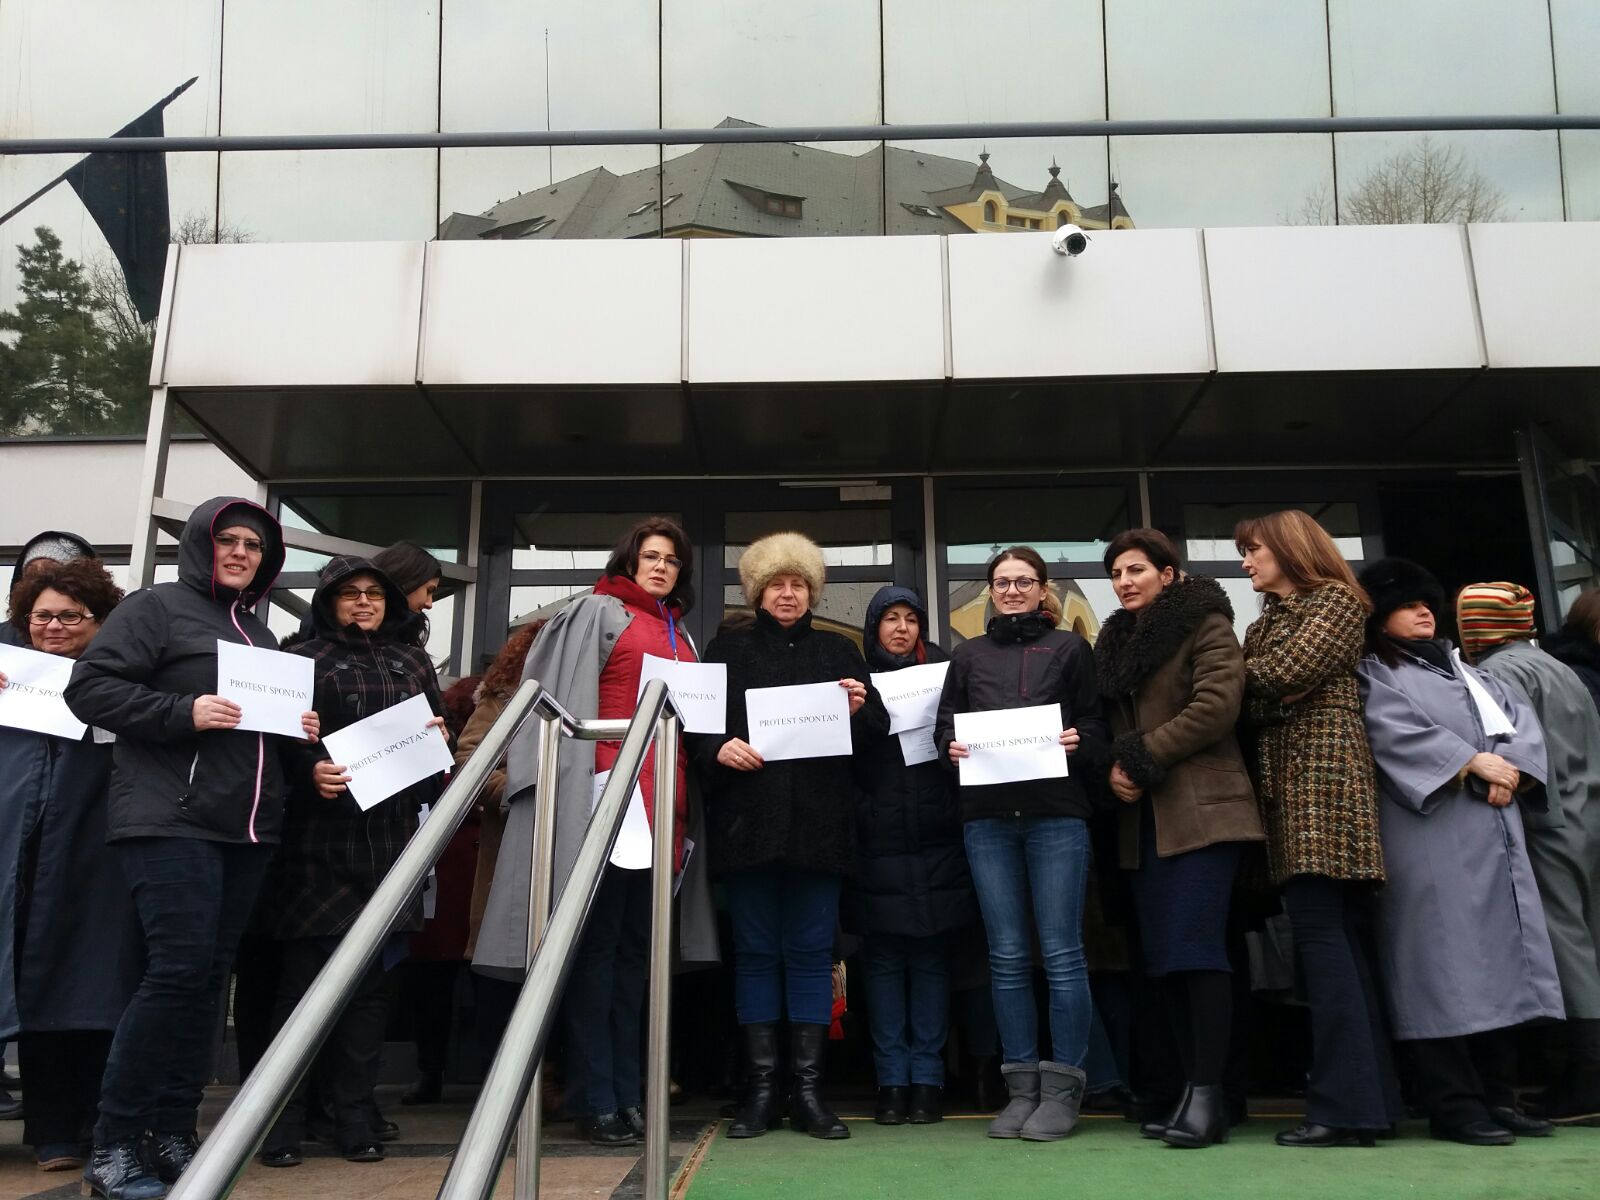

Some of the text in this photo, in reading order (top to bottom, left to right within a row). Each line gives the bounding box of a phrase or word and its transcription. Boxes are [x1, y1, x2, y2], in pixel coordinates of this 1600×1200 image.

[3, 681, 64, 699] OTEST SPON
[230, 678, 308, 700] PROTEST SPONTAN
[678, 691, 717, 701] SPONTAN
[886, 686, 943, 703] PROTEST SPON
[759, 714, 840, 728] PROTEST SPONTAN
[349, 728, 430, 773] PROTEST SPONTAN
[967, 735, 1053, 751] PROTEST SPONTAN
